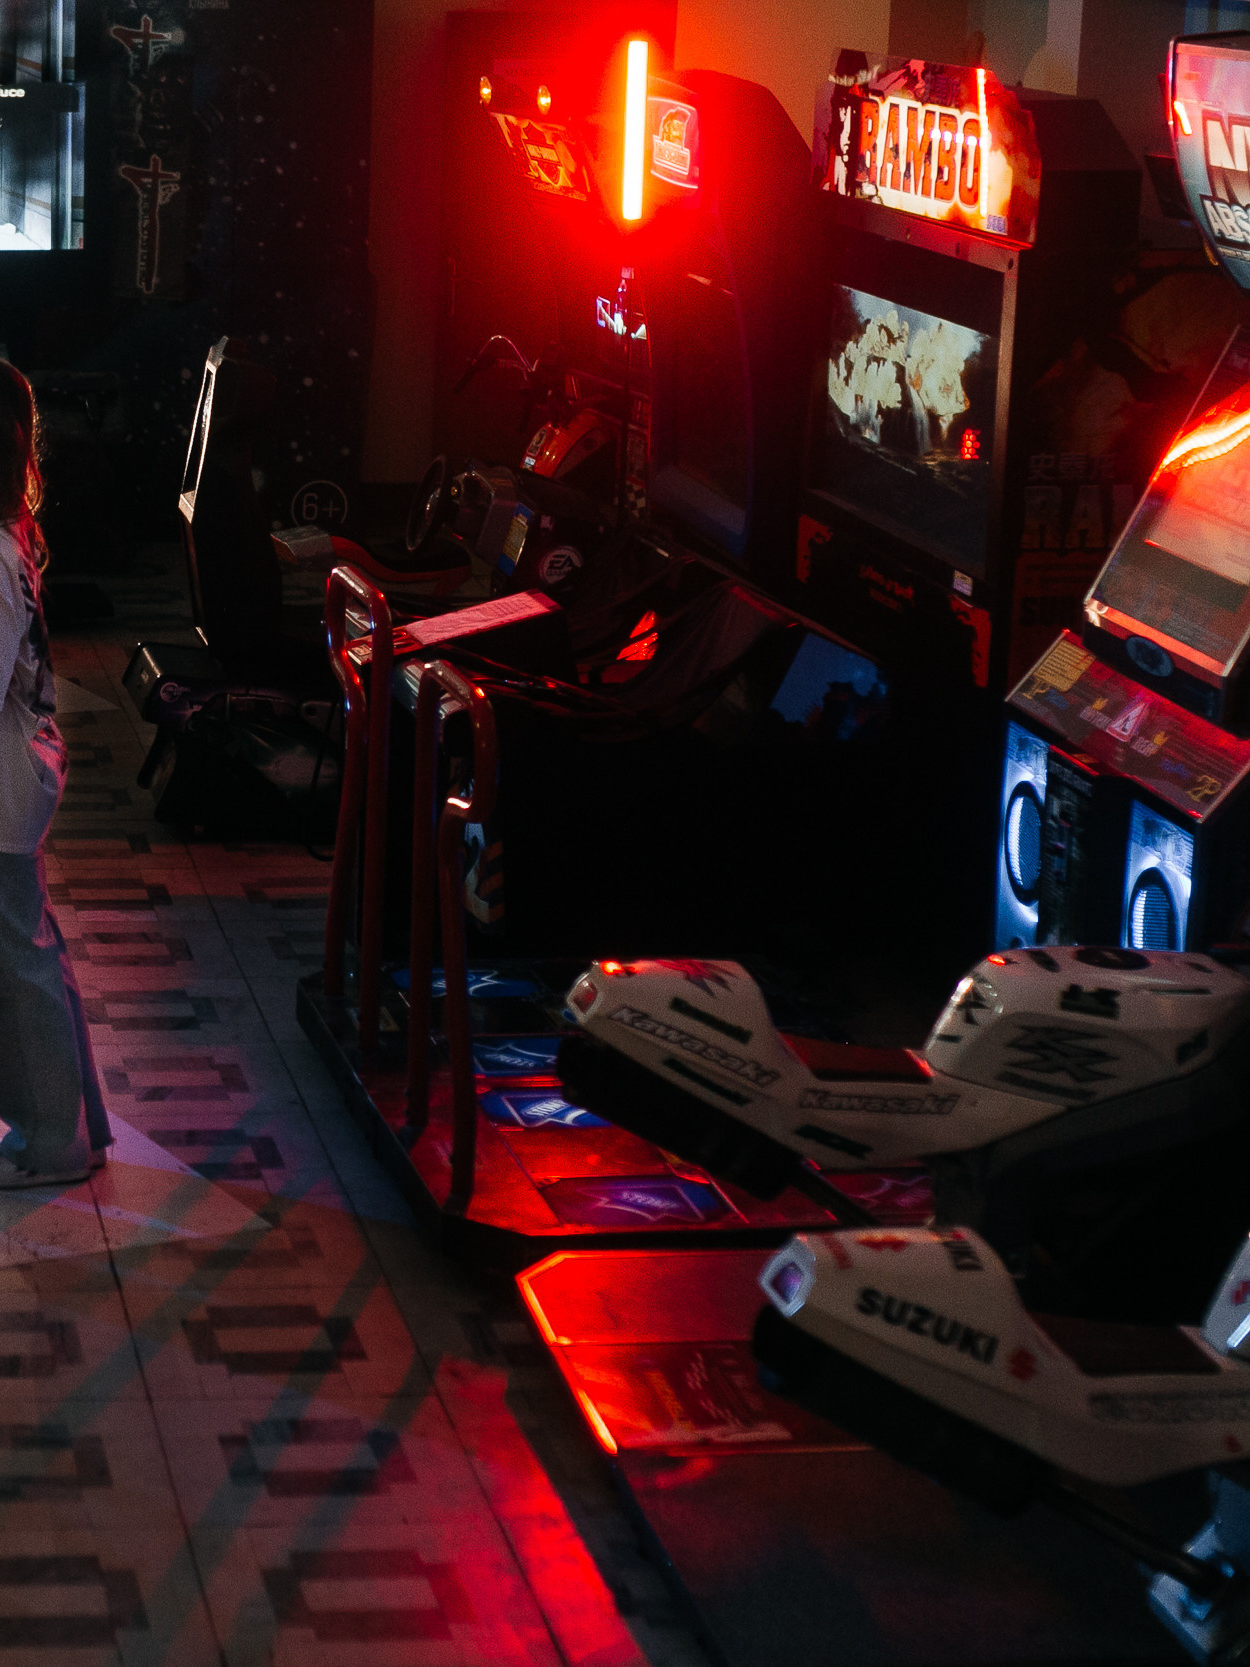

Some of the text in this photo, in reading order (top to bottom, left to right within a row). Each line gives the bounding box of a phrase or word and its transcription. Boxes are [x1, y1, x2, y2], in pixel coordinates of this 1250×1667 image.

[856, 99, 981, 208] RAMBO
[302, 493, 340, 521] 6+
[608, 1006, 781, 1087] Kawasaki
[856, 1288, 999, 1365] SUZUKI
